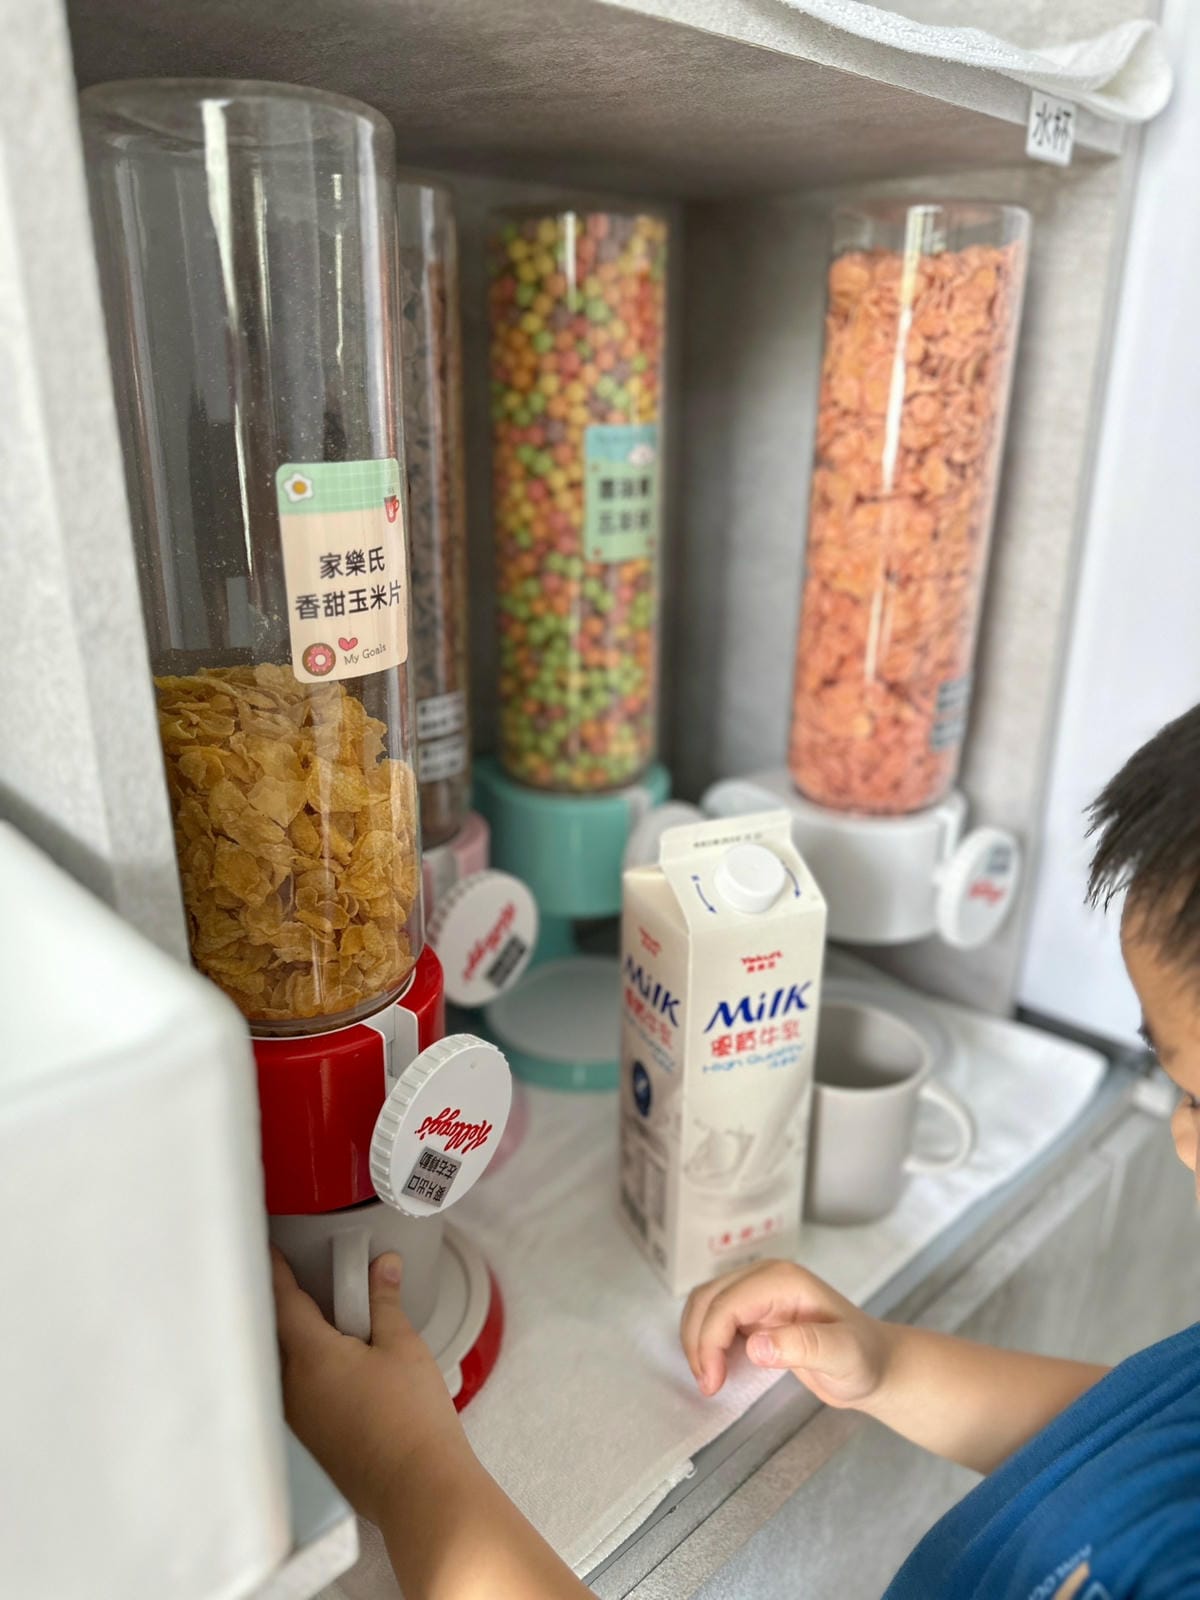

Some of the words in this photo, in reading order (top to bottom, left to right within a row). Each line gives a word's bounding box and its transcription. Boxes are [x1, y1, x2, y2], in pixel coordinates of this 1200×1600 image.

[1032, 101, 1072, 153] 水杯
[319, 546, 385, 579] 家樂氏
[295, 580, 402, 620] 香甜玉米片
[344, 654, 360, 666] My
[362, 643, 387, 659] Goals
[415, 1107, 492, 1154] Kellogg's
[419, 1151, 457, 1179] 左右轉動
[408, 1175, 446, 1202] 麥片出口
